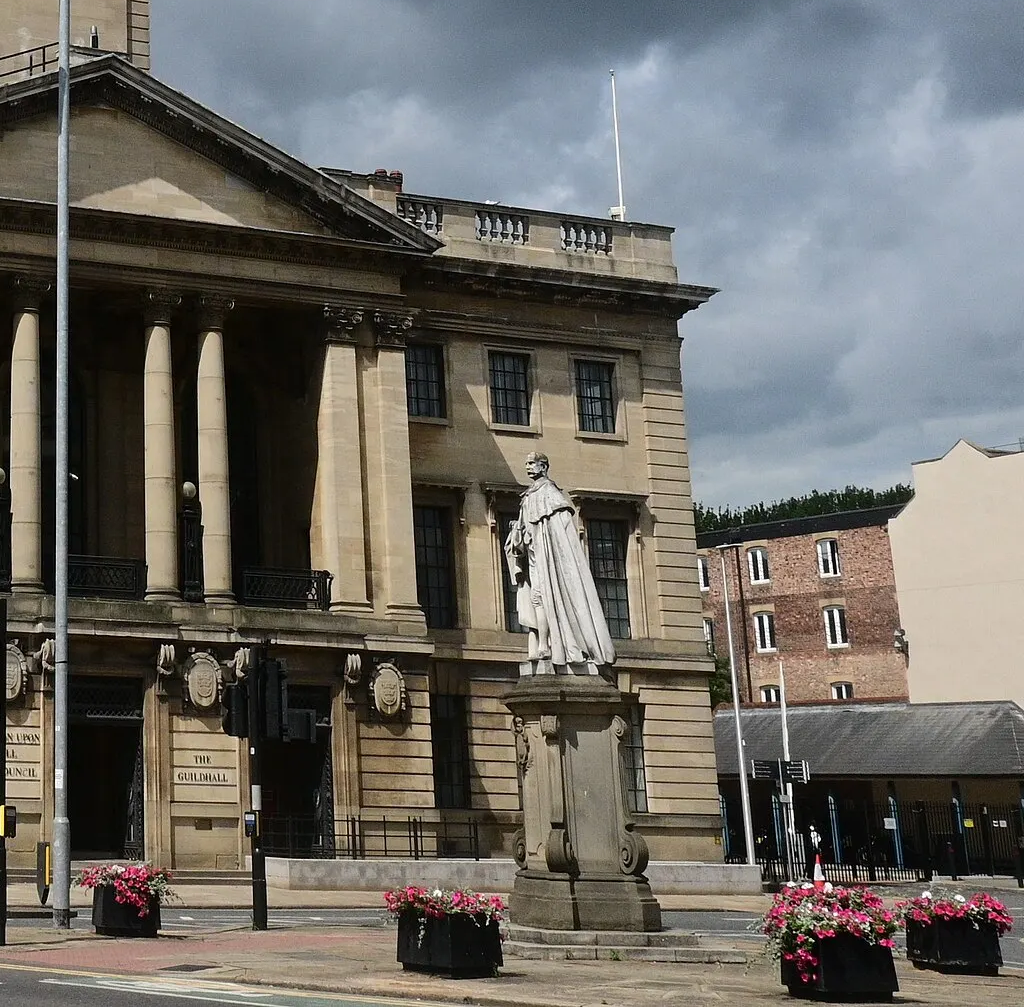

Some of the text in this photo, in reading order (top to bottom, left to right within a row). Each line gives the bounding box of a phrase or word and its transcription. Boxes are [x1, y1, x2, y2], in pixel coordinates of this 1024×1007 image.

[16, 733, 40, 743] UPON
[193, 755, 211, 764] THE
[5, 767, 37, 777] UNCIL
[177, 772, 228, 783] GUILDHALL
